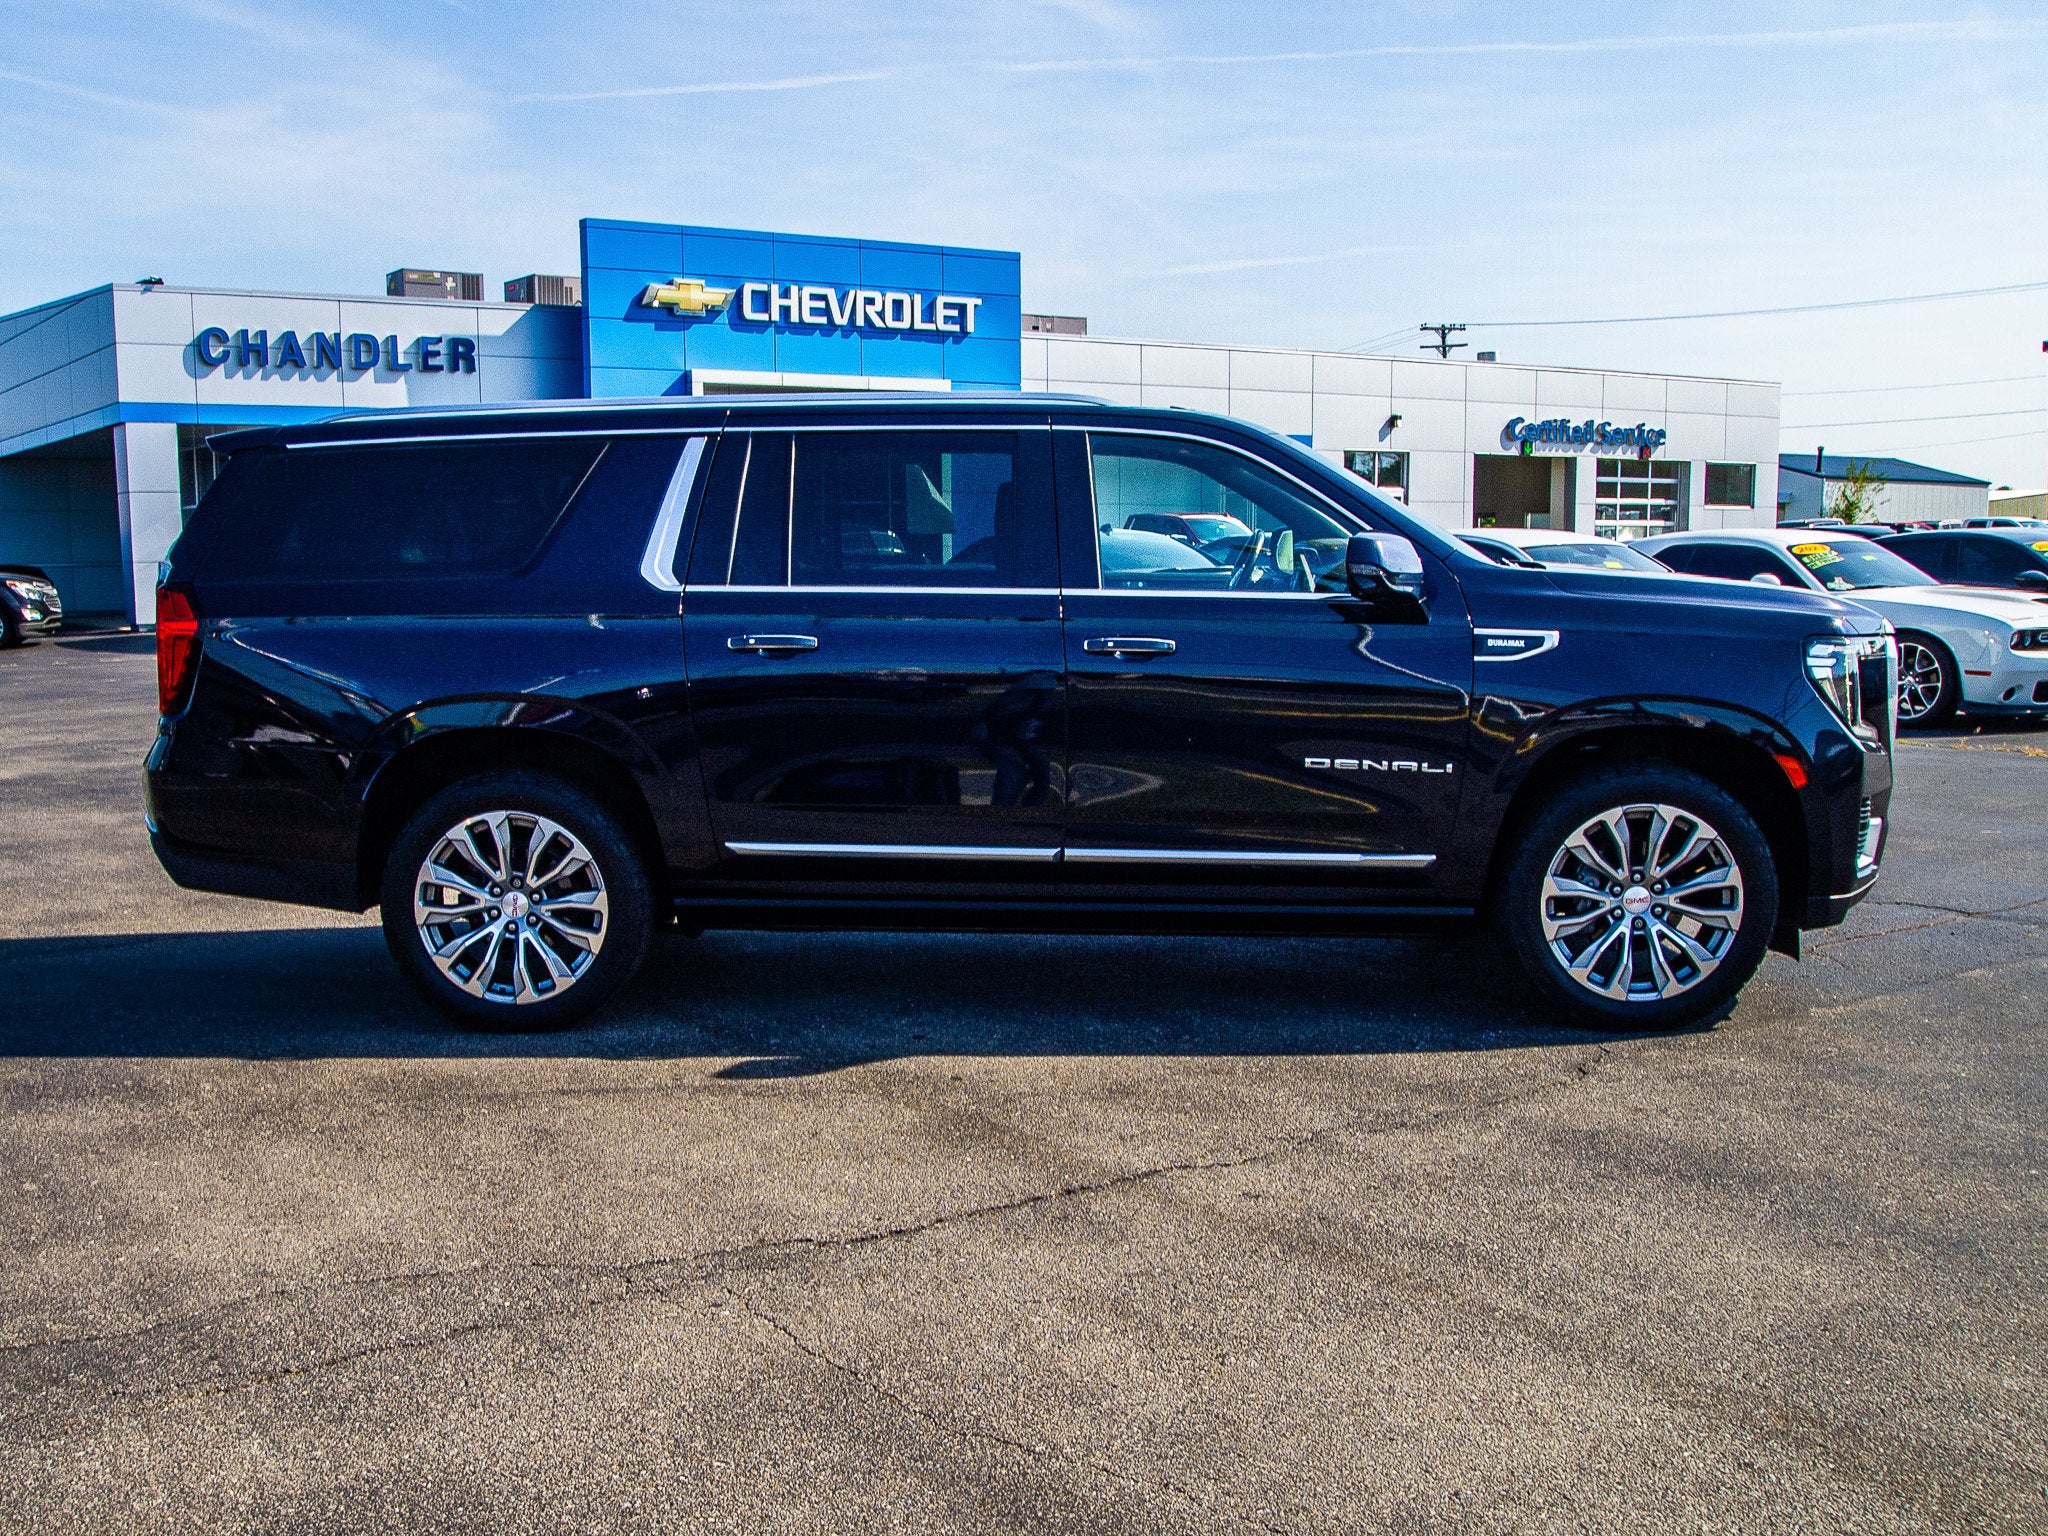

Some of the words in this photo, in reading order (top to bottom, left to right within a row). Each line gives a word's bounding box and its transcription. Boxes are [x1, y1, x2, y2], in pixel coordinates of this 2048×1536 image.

[742, 281, 983, 333] CHEVROLET
[199, 326, 477, 374] CHANDLER
[1510, 416, 1595, 443] Certified
[1600, 421, 1667, 446] Service
[1487, 638, 1525, 648] DURAMAX
[1304, 757, 1453, 774] DENALI
[1625, 896, 1649, 905] GMC
